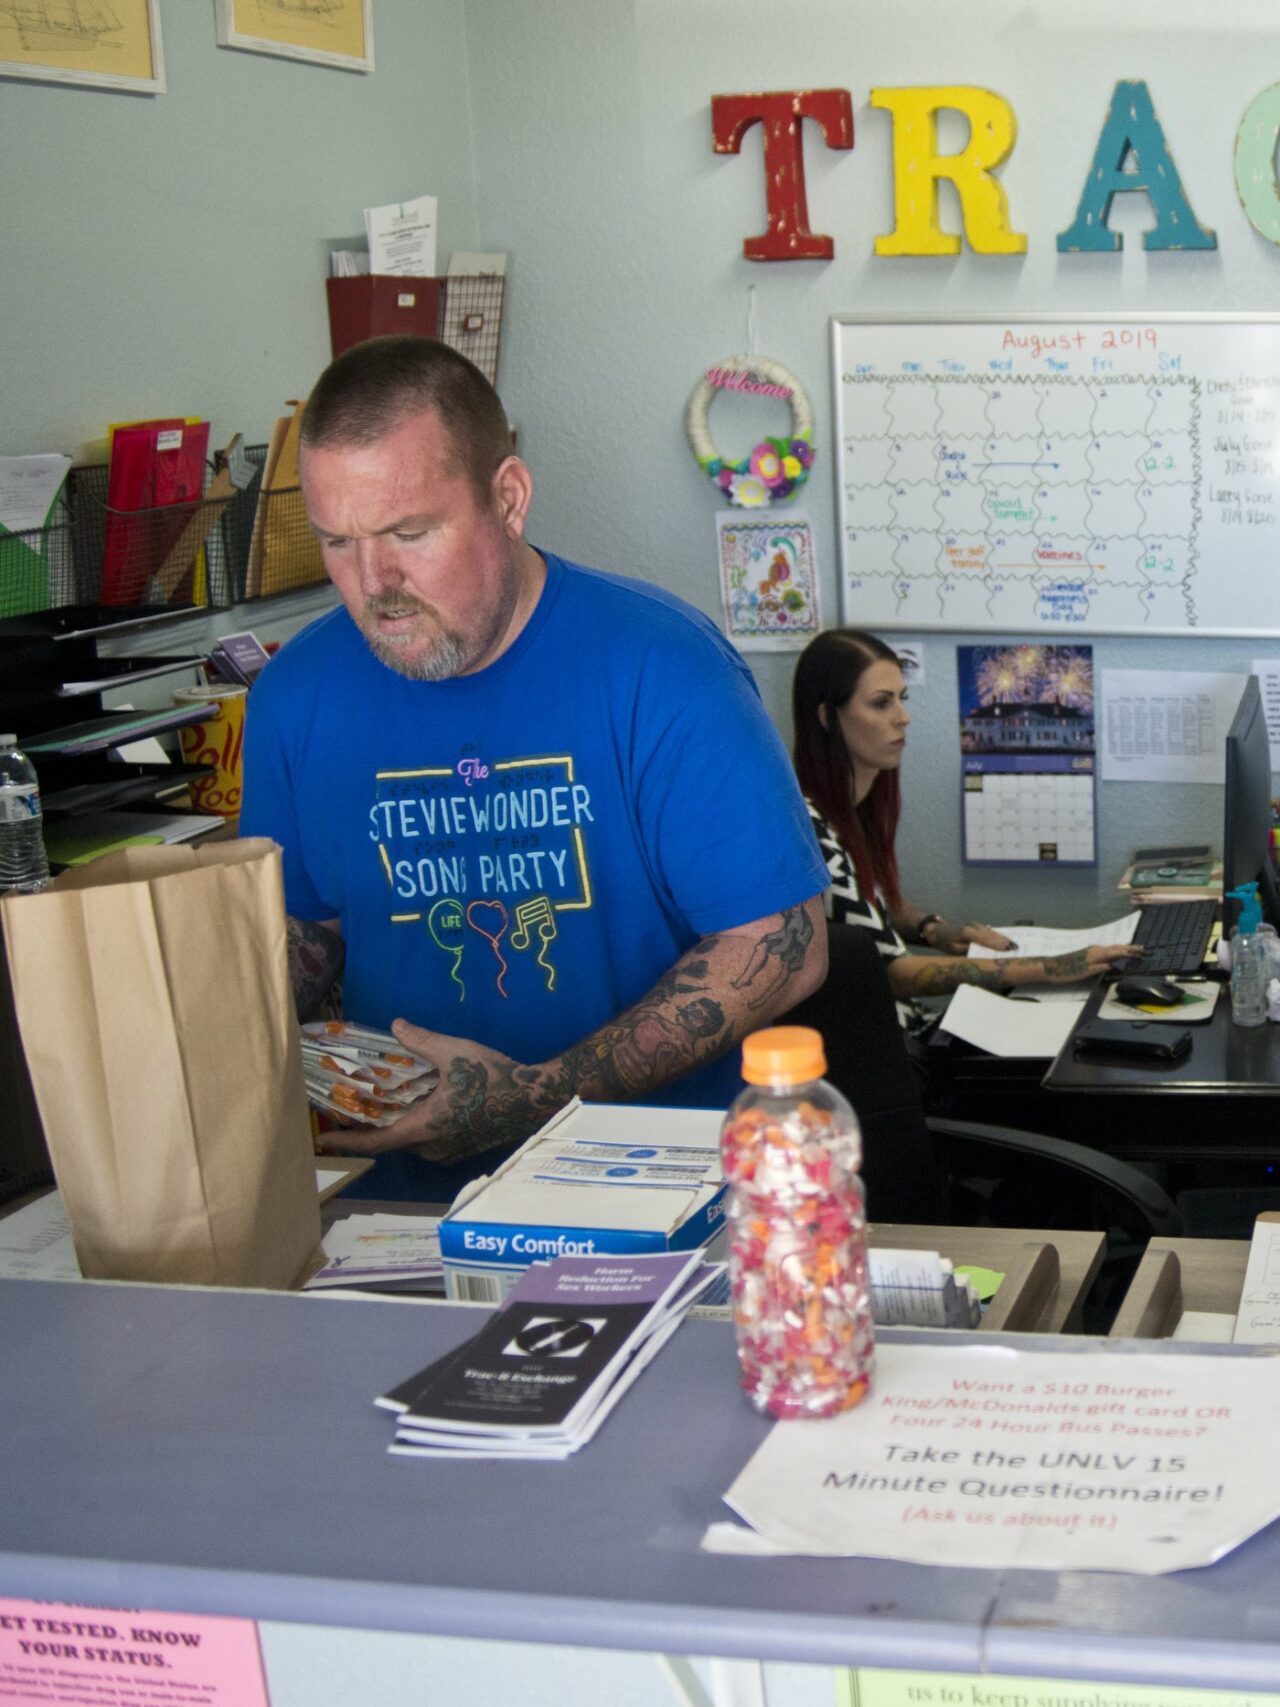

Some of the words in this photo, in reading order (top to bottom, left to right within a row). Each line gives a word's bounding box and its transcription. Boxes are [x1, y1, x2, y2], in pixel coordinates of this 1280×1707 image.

[1001, 329, 1085, 358] August
[1101, 328, 1157, 349] 2019
[988, 357, 1014, 372] Wed
[1092, 356, 1113, 373] Fri
[705, 366, 795, 399] Welcome
[457, 757, 490, 787] The
[479, 848, 568, 893] PARTY
[441, 915, 462, 929] LIFE
[463, 1230, 507, 1255] Easy
[511, 1234, 596, 1255] Comfort
[510, 1372, 578, 1385] Exchange
[951, 1379, 1015, 1393] Want
[1021, 1383, 1036, 1394] a
[1095, 1383, 1177, 1399] Burger
[881, 1396, 1080, 1415] King/McDonalds
[1085, 1402, 1127, 1417] gift
[1134, 1406, 1190, 1419] card
[1194, 1407, 1232, 1420] OR
[888, 1414, 947, 1427] Four
[952, 1417, 983, 1430] 24
[990, 1420, 1053, 1434] Hour
[1058, 1421, 1103, 1434] Bus
[1110, 1422, 1208, 1438] Passes?
[884, 1444, 960, 1464] Take
[972, 1450, 1027, 1469] the
[1039, 1452, 1136, 1471] UNLV
[1146, 1456, 1188, 1474] 15
[822, 1470, 948, 1494] Minute
[958, 1477, 1225, 1503] Questionnaire!
[901, 1506, 958, 1524] (Ask
[966, 1513, 994, 1525] us
[1002, 1511, 1081, 1527] about
[1089, 1513, 1119, 1530] it)
[0, 1615, 26, 1631] ET
[31, 1618, 126, 1641] TESTED.
[131, 1627, 202, 1648] KNOW
[18, 1640, 80, 1660] YOUR
[84, 1646, 173, 1669] STATUS.
[907, 1686, 933, 1702] us
[941, 1686, 964, 1705] to
